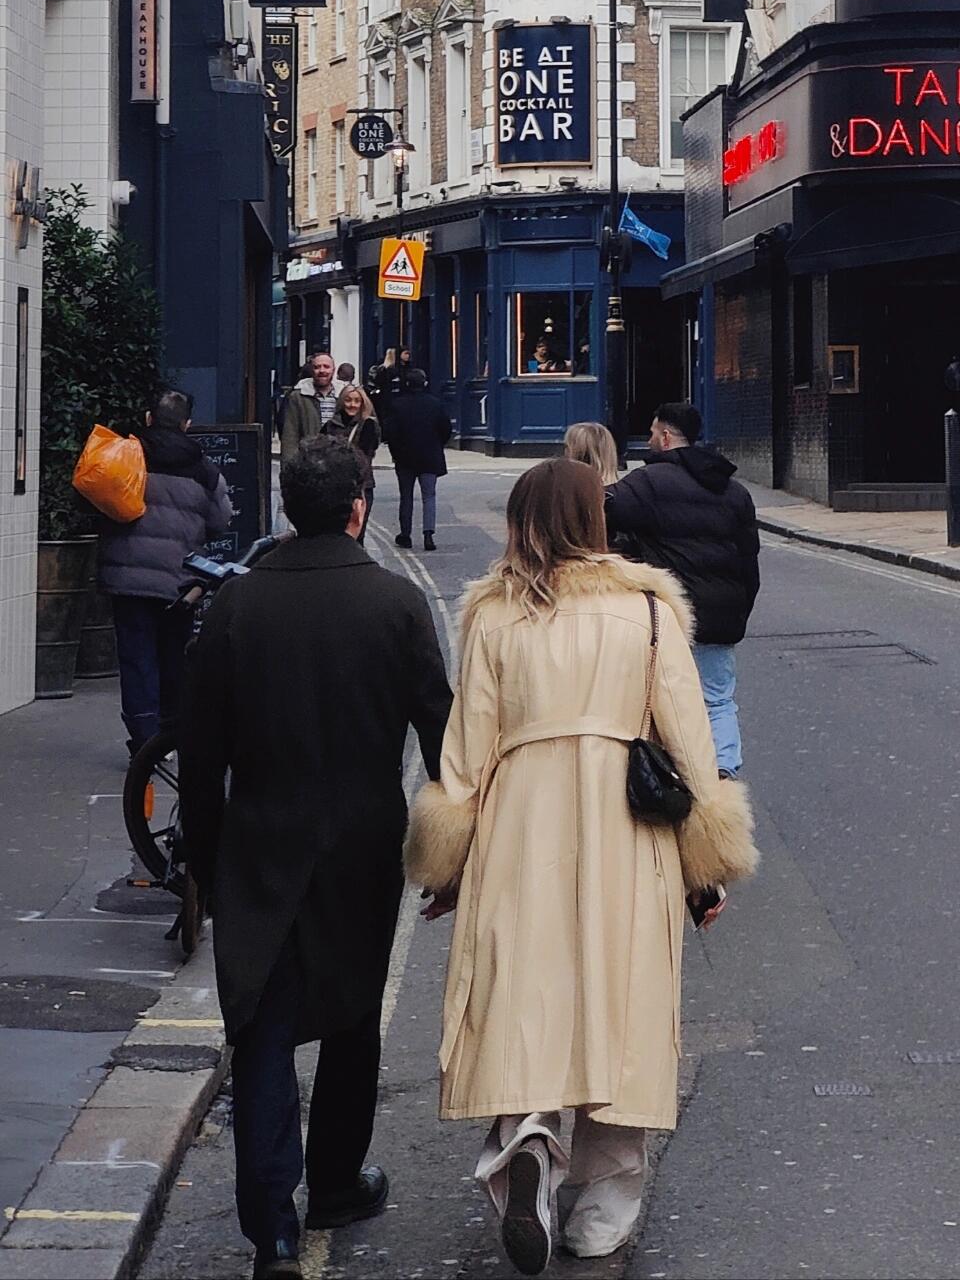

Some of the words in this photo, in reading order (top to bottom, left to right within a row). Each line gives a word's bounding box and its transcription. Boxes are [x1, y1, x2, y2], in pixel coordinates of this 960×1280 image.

[499, 47, 525, 68] BE
[537, 45, 573, 66] AT
[499, 68, 574, 96] ONE
[499, 97, 574, 111] COCKTAIL
[358, 129, 385, 138] ONE
[499, 112, 574, 142] BAR
[358, 142, 385, 152] BAR
[387, 283, 411, 293] School
